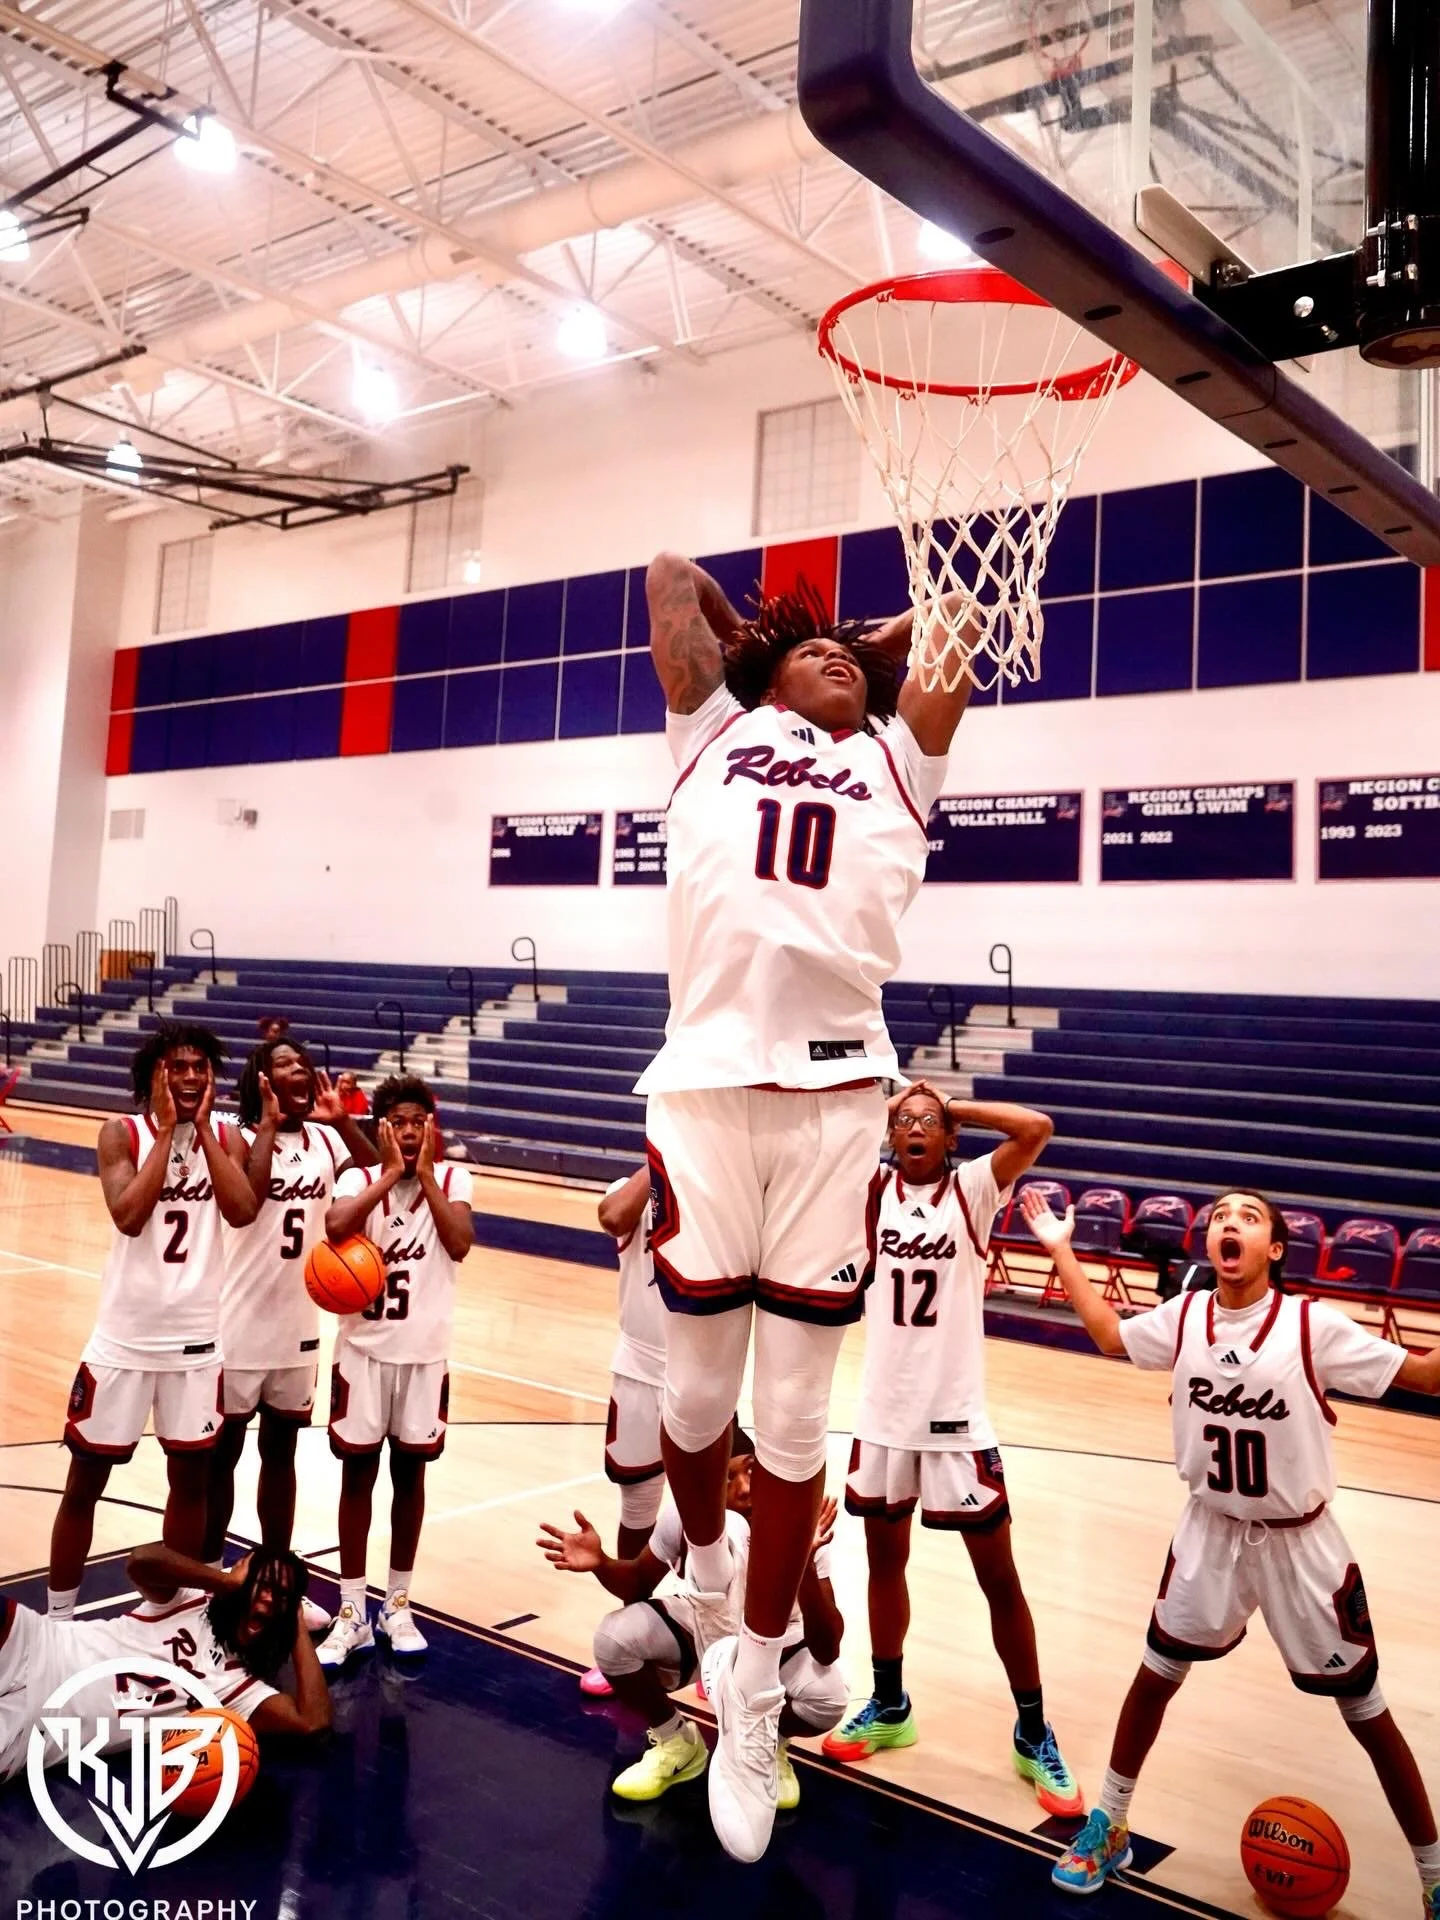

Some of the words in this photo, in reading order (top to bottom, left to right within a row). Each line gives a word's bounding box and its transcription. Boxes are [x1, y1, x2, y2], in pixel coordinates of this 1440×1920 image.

[723, 745, 872, 801] Rebels
[1348, 778, 1423, 795] REGION
[939, 798, 993, 812] REGION
[995, 796, 1057, 810] CHAMPS
[1128, 789, 1191, 804] REGION
[1193, 785, 1265, 801] CHAMPS
[1141, 801, 1194, 816] GIRLS
[1196, 799, 1248, 814] SWIM
[1372, 794, 1440, 811] SOFTB
[948, 812, 1046, 827] VOLLEYBALL
[1364, 824, 1403, 839] 2023
[754, 798, 836, 890] 10
[1102, 832, 1133, 845] 2021
[1140, 830, 1173, 844] 2022
[158, 1176, 213, 1202] ebels
[267, 1175, 326, 1202] Rebels
[163, 1210, 188, 1263] 2
[280, 1208, 305, 1260] 5
[879, 1228, 957, 1260] Rebels
[377, 1237, 427, 1266] bels
[891, 1268, 938, 1327] 12
[1188, 1377, 1290, 1421] Rebels
[1203, 1423, 1269, 1498] 30
[1248, 1818, 1314, 1856] Wilson
